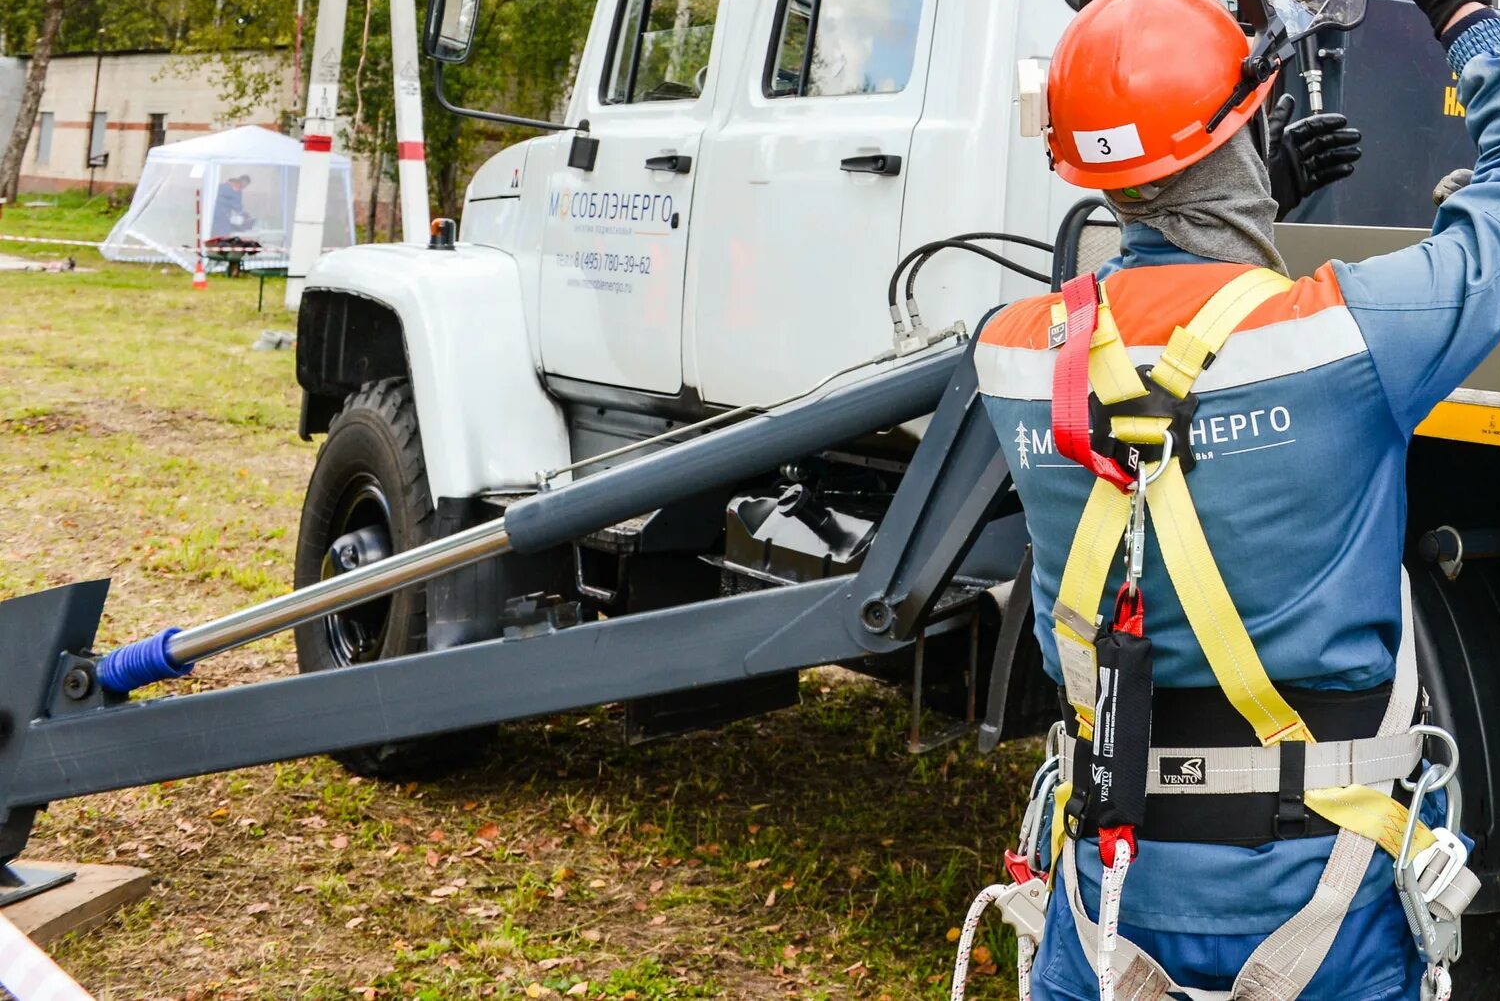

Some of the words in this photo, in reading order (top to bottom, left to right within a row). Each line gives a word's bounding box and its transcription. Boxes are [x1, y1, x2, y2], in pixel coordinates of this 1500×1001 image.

[1097, 137, 1112, 155] 3
[550, 191, 673, 223] МОСОБЛЭНЕРГО
[1100, 770, 1111, 802] VENTO
[1163, 774, 1198, 784] VENTO
